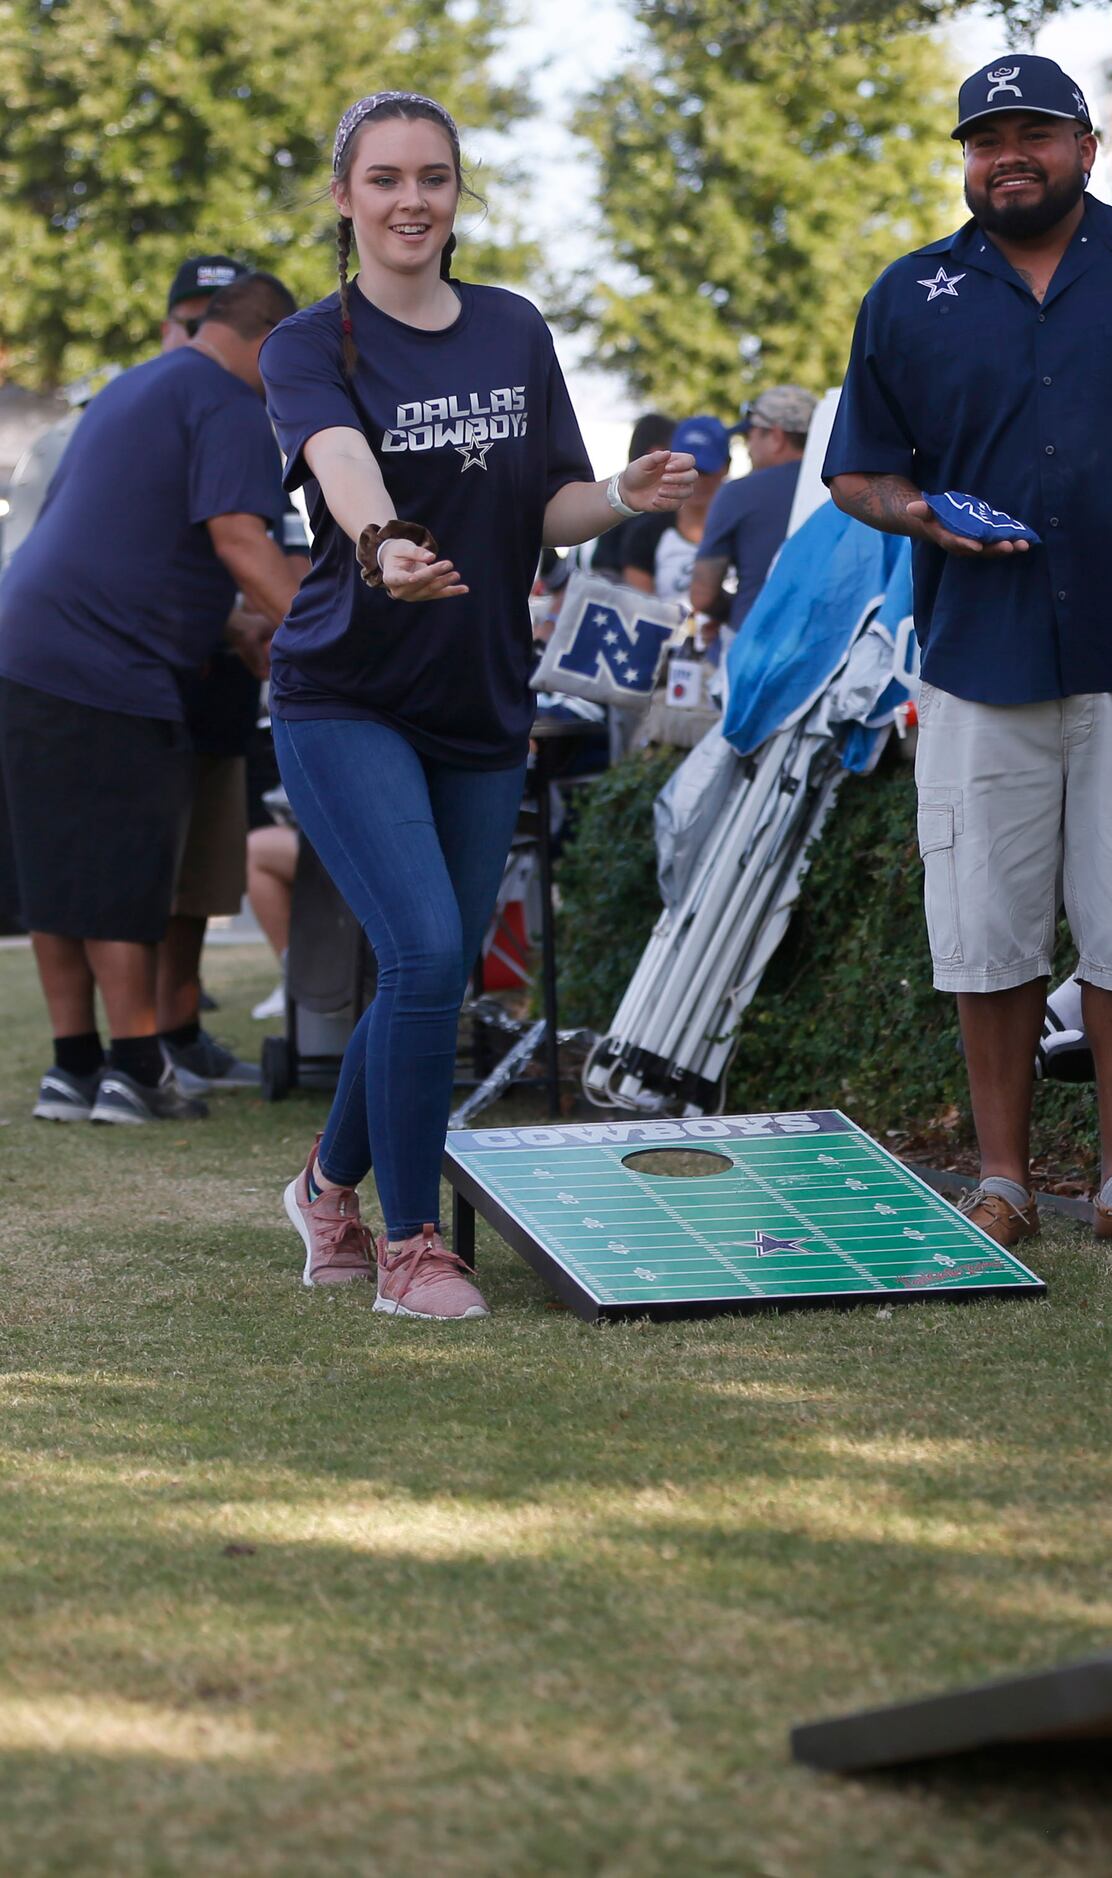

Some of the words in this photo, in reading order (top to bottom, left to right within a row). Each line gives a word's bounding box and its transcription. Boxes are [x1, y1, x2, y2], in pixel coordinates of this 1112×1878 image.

[396, 385, 526, 428] DALLAS
[380, 412, 528, 453] COWBOYS
[557, 602, 674, 692] N
[472, 1114, 822, 1149] COWBOYS
